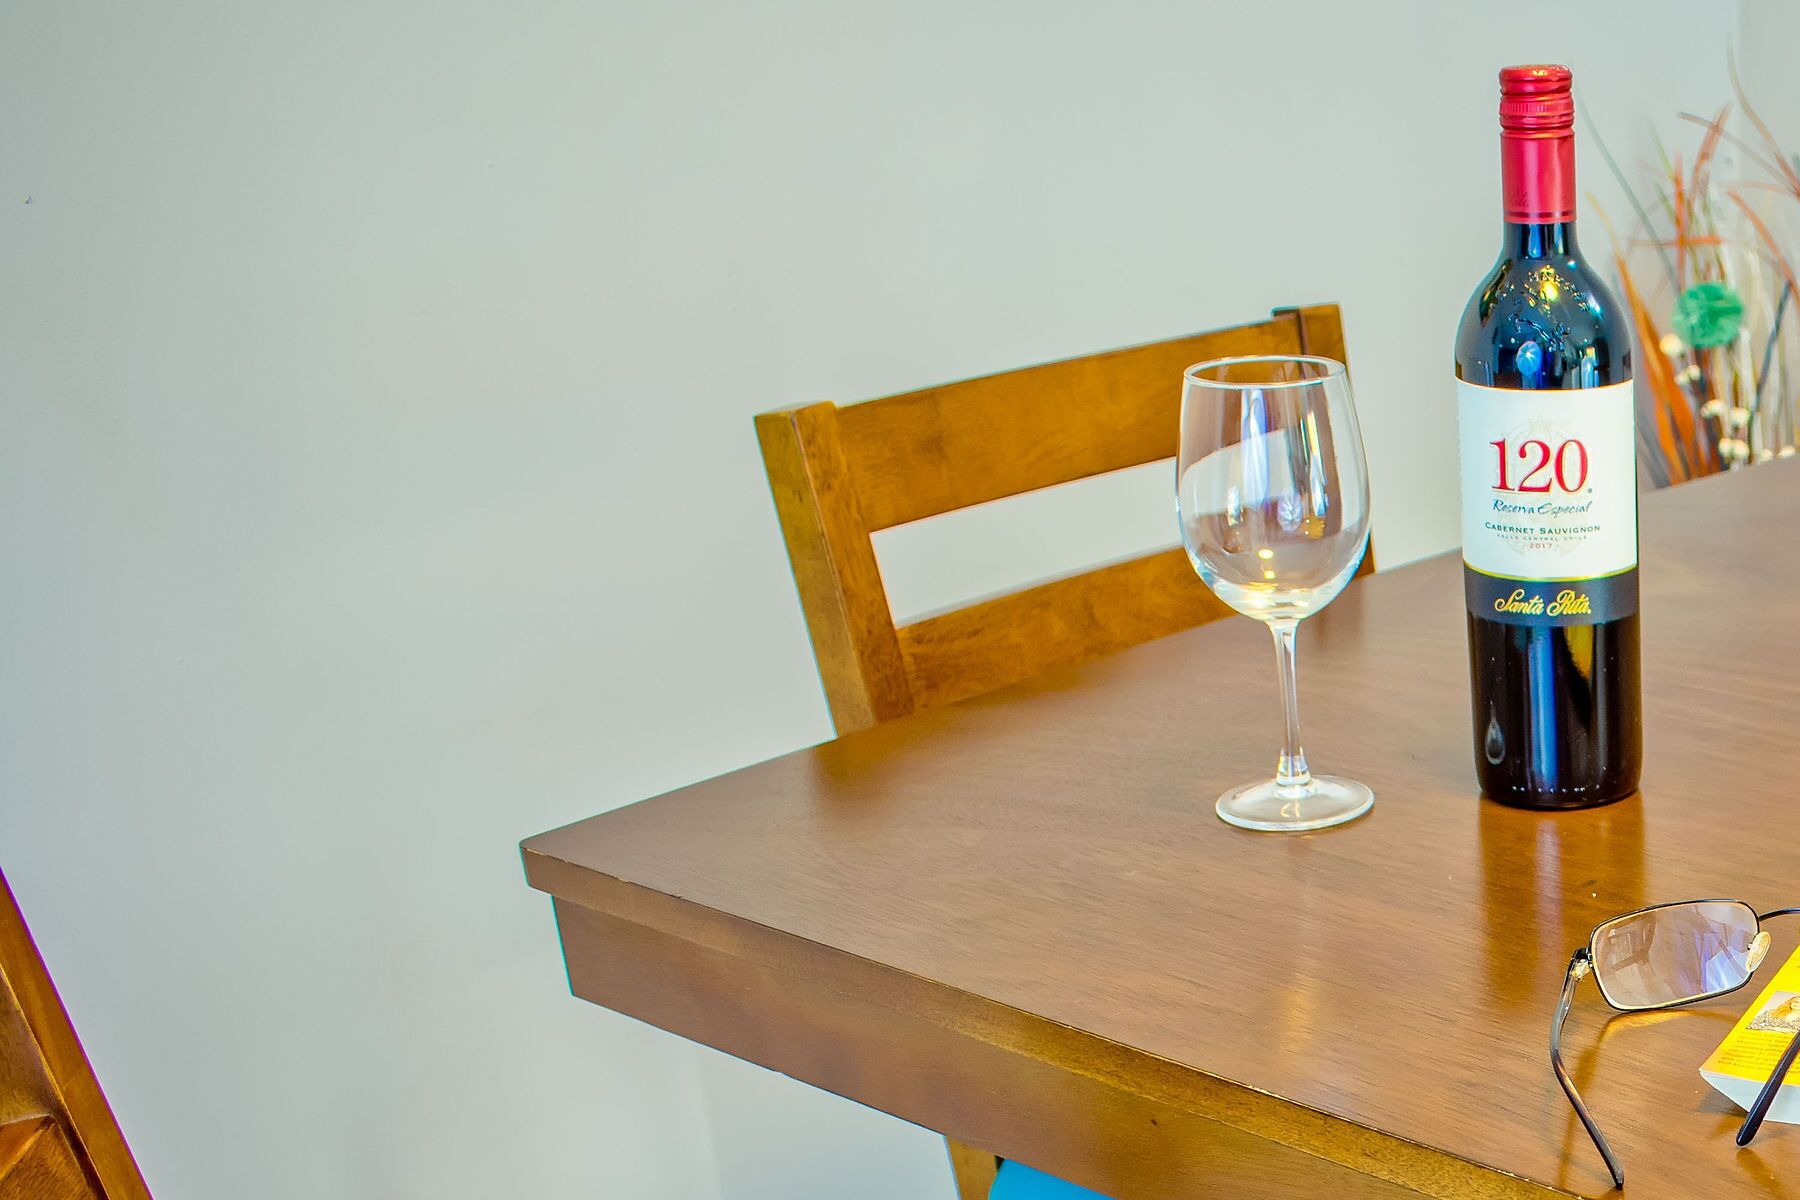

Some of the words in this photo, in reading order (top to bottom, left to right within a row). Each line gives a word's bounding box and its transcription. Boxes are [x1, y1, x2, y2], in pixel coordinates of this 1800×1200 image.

[1489, 438, 1589, 493] 120
[1492, 498, 1535, 514] Reserva
[1537, 501, 1592, 518] Especial
[1485, 521, 1534, 534] CABERNET
[1540, 524, 1600, 535] SAUVIGNON
[1494, 588, 1544, 615] Santa
